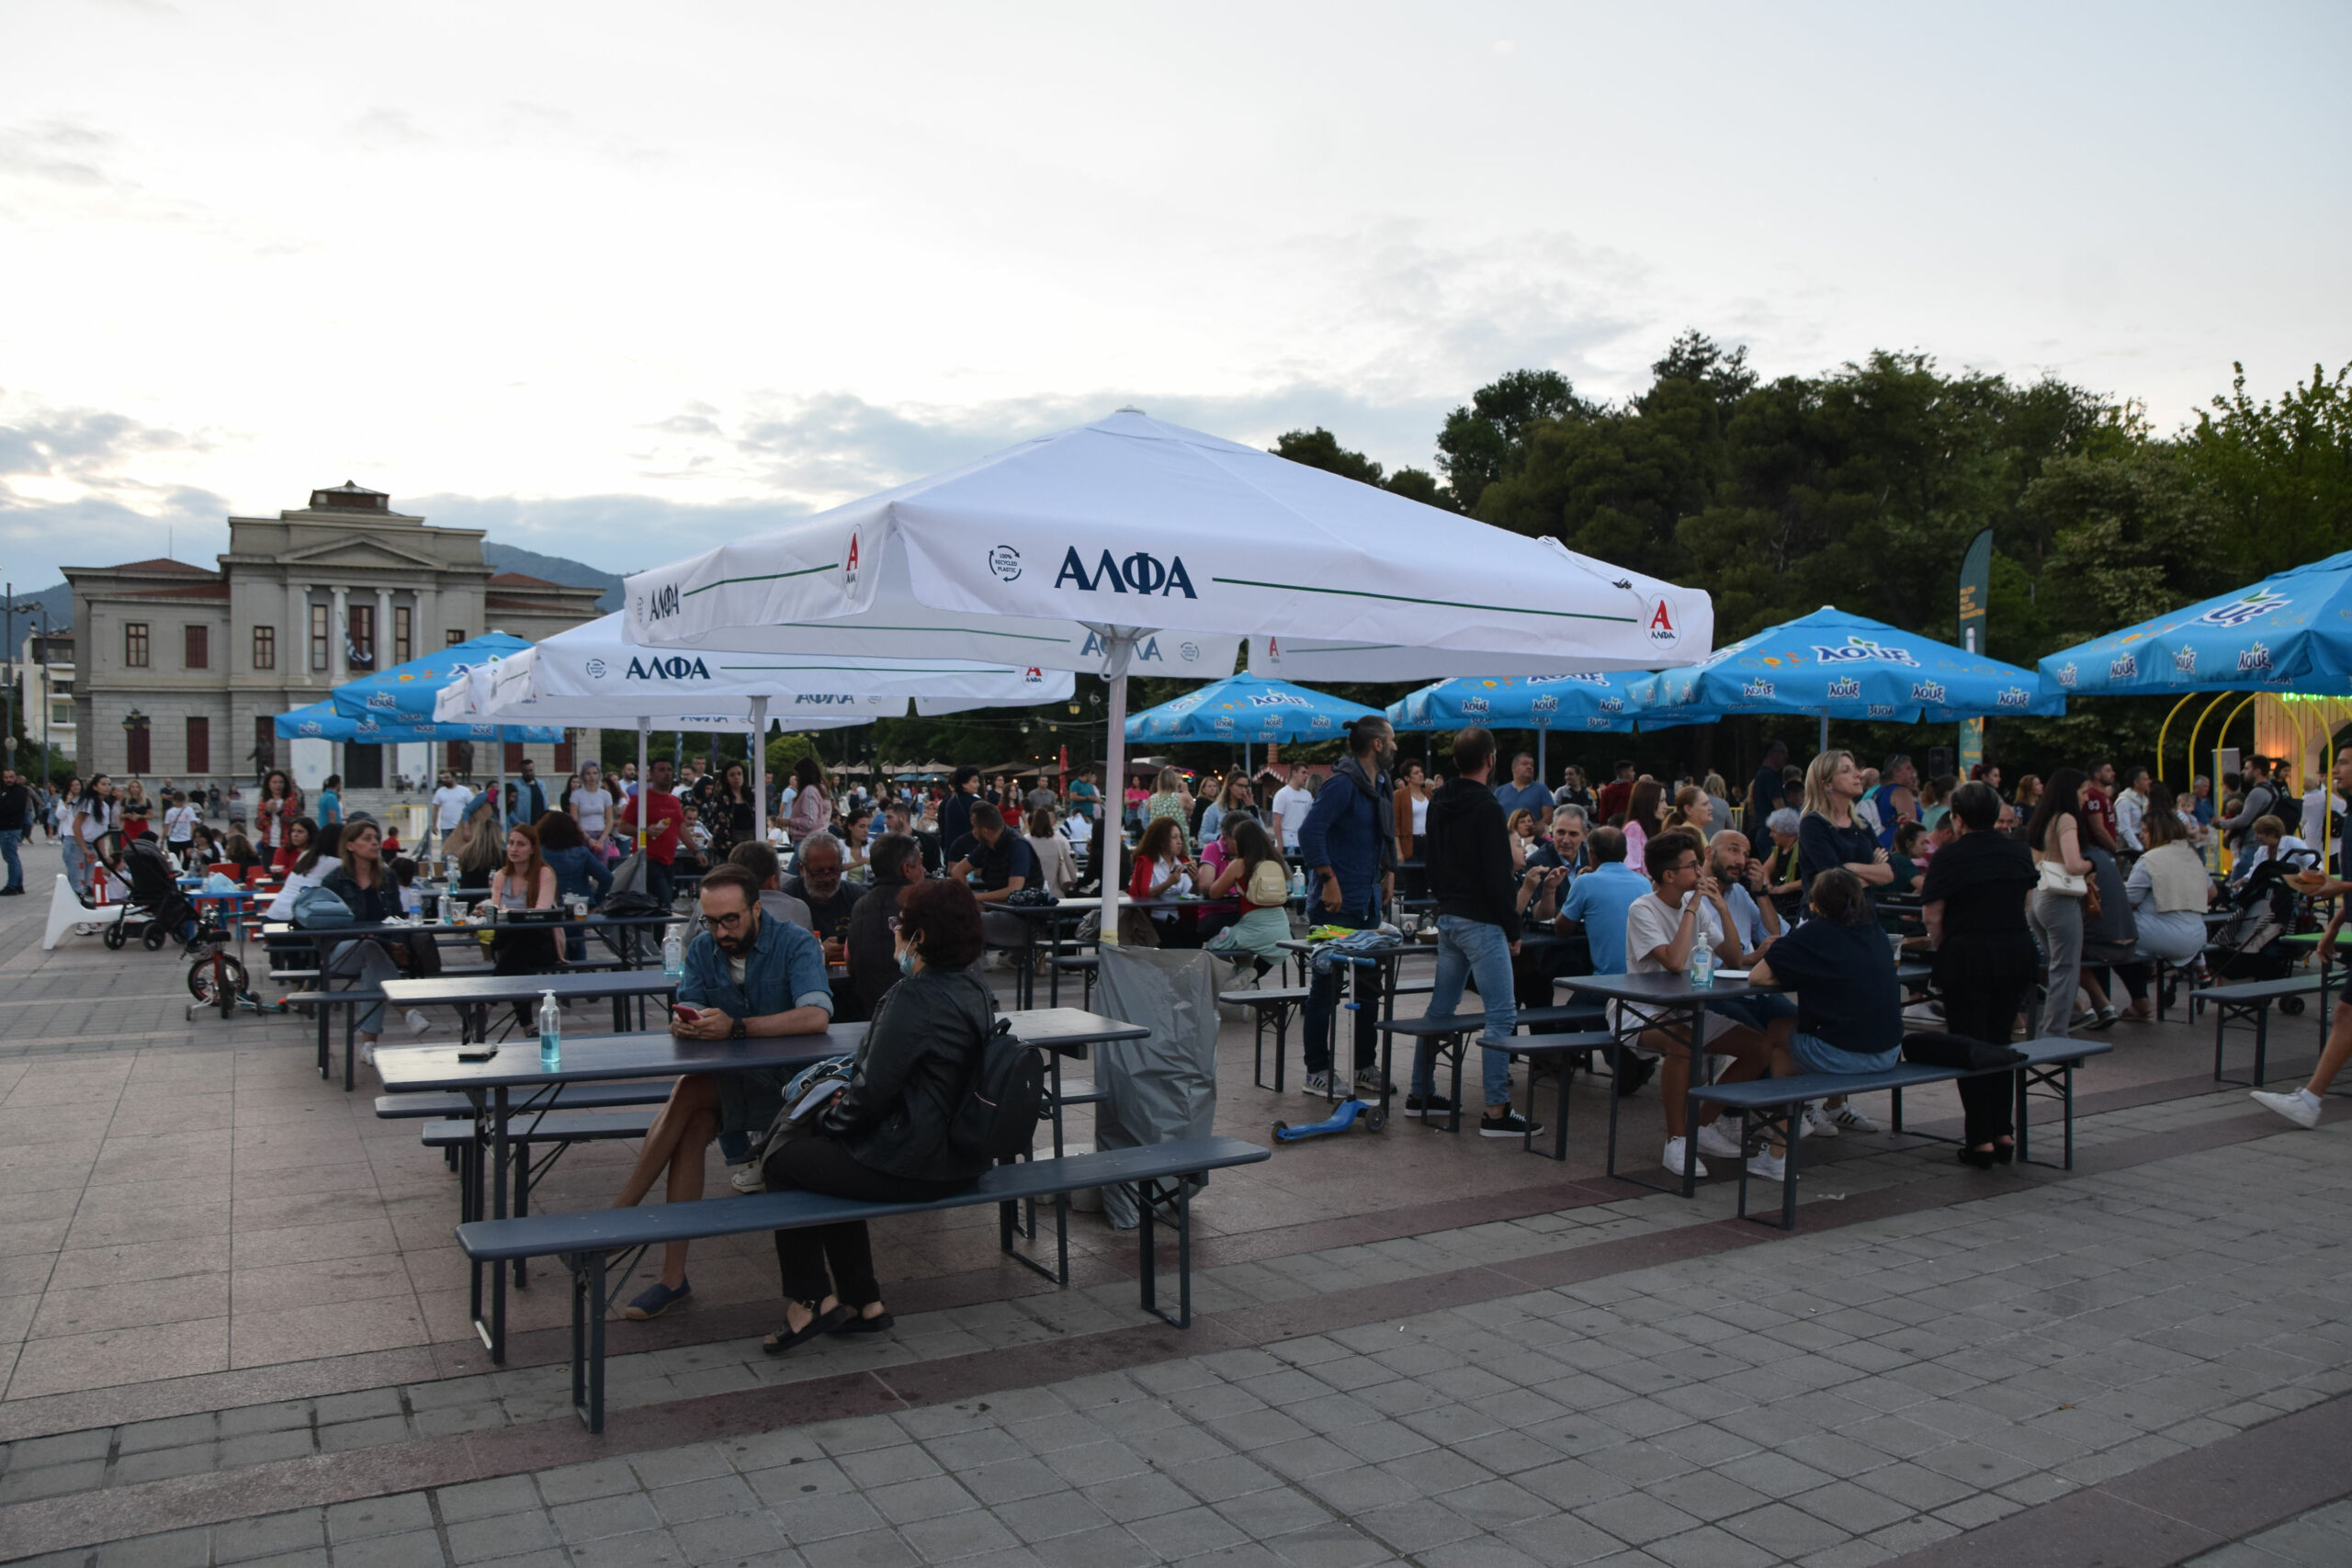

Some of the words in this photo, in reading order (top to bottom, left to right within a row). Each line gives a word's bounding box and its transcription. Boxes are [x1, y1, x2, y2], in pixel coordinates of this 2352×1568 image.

[1054, 546, 1198, 599] ΑΛΦΑ
[650, 582, 680, 622] ΑΛΦΑ
[626, 656, 712, 680] ΑΛΦΑ
